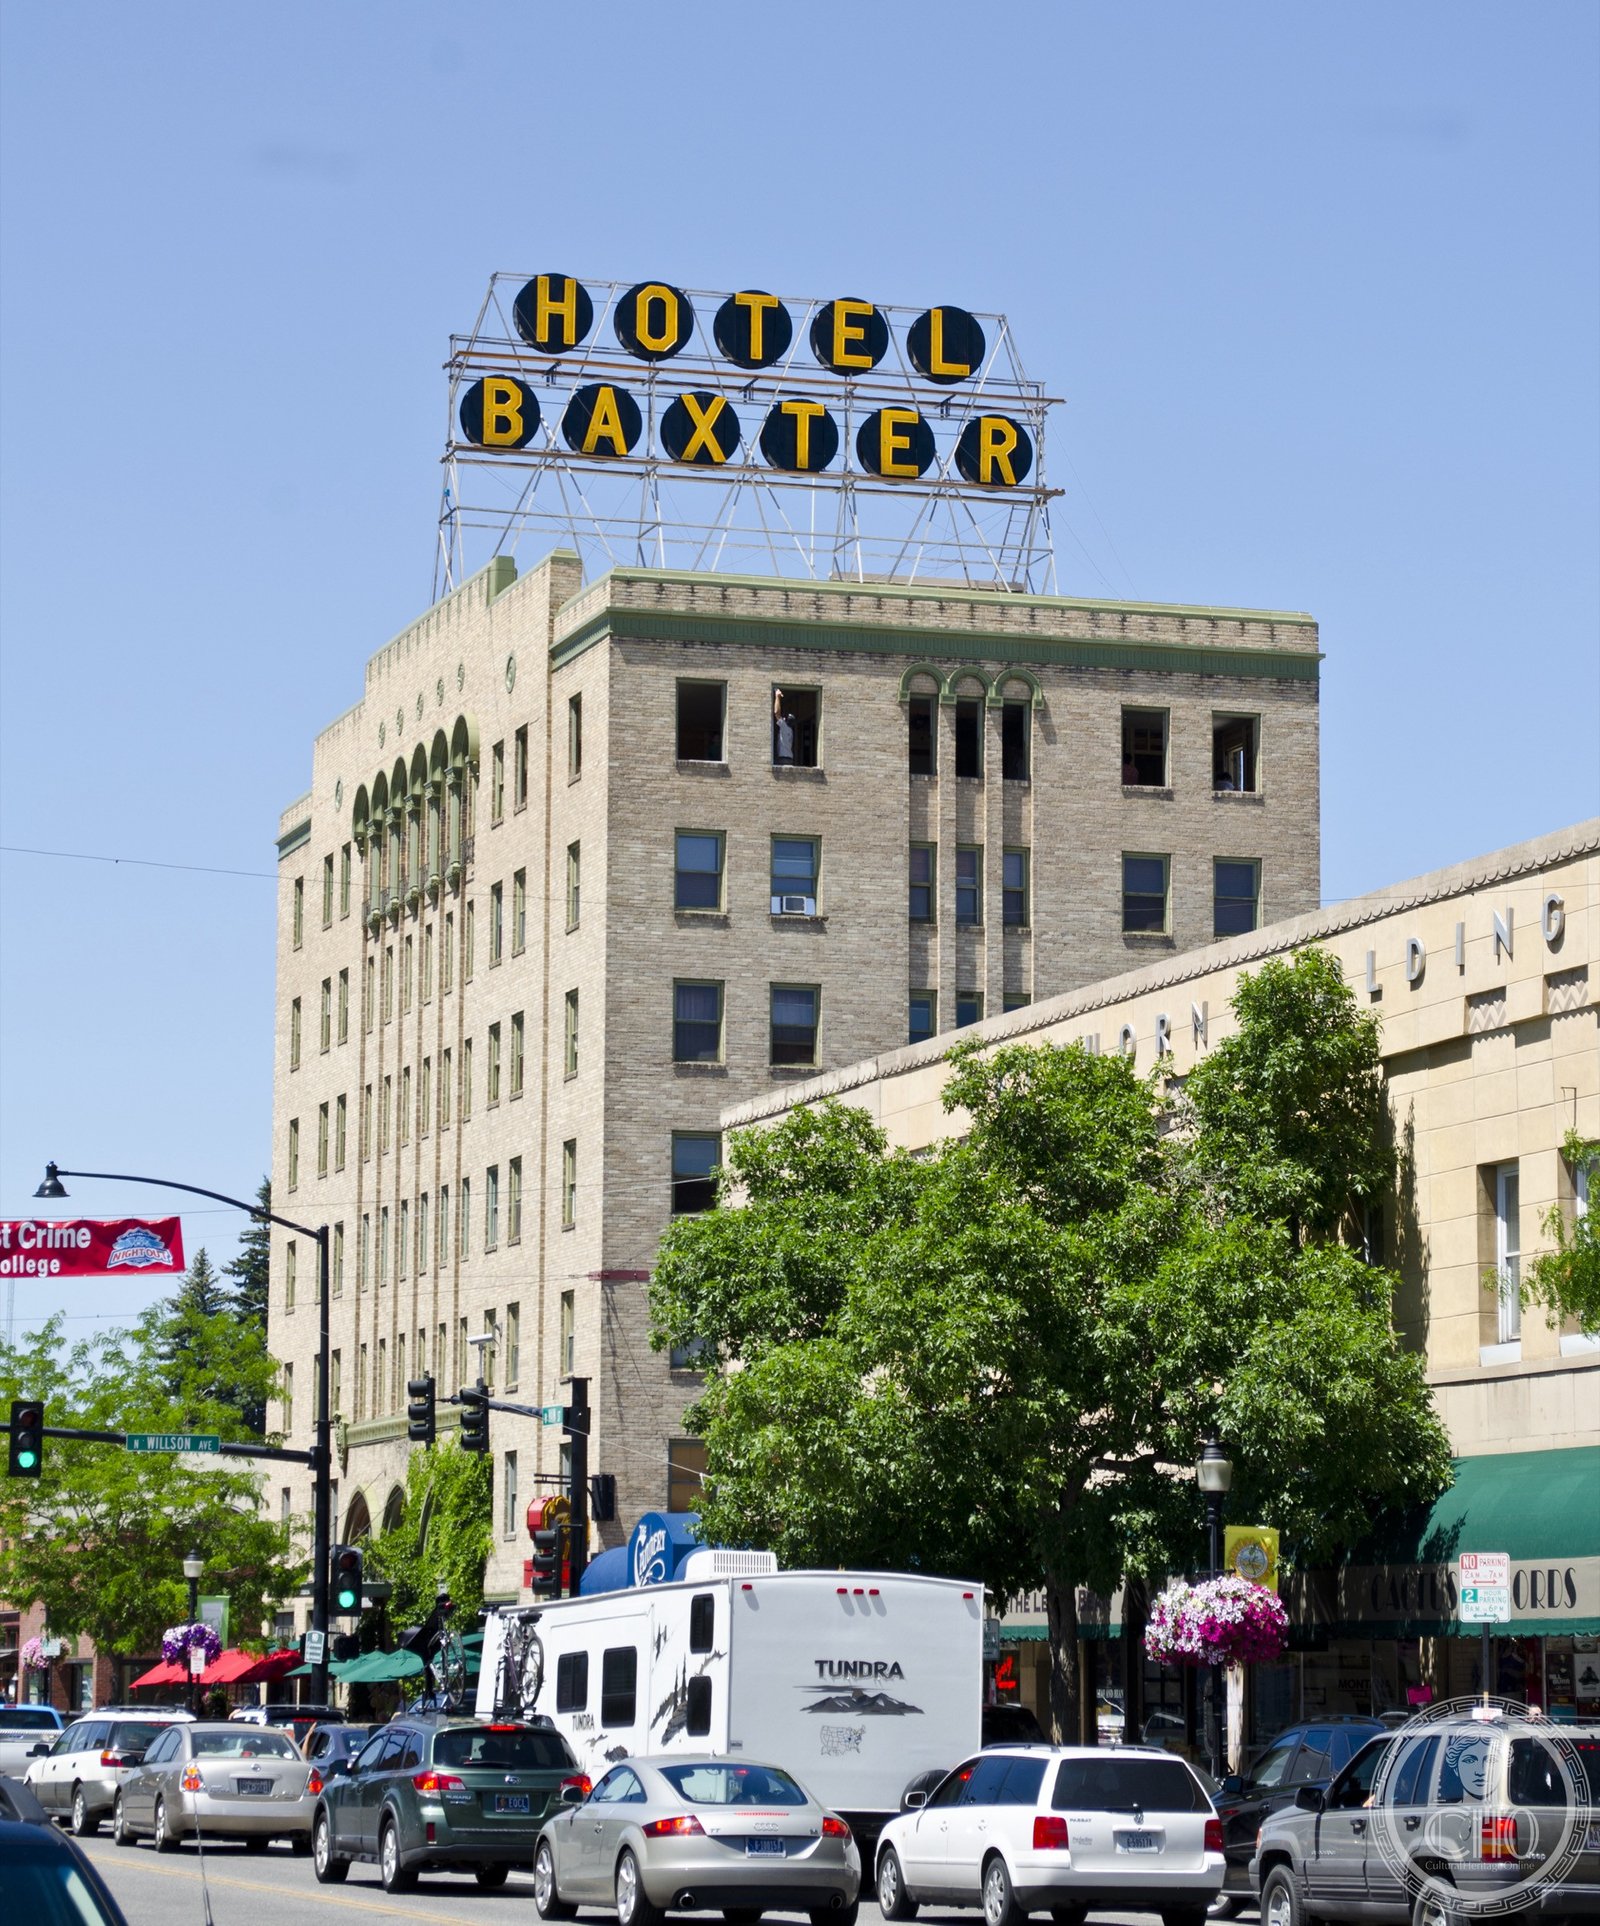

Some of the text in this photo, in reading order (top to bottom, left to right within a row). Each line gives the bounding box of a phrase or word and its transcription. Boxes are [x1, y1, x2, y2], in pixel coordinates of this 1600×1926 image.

[536, 275, 969, 376] HOTEL
[482, 377, 1017, 485] BAXTER
[18, 1222, 91, 1249] Crime
[113, 1248, 167, 1262] NIGHT OUT
[133, 1436, 213, 1451] N WILLSON AVE
[1463, 1555, 1506, 1569] NO PARKING
[1371, 1567, 1577, 1612] CACTUS ORDS
[1465, 1589, 1474, 1603] 2
[1480, 1596, 1506, 1604] PARKING
[815, 1660, 904, 1680] TUNDRA
[572, 1714, 595, 1731] TUNDRA
